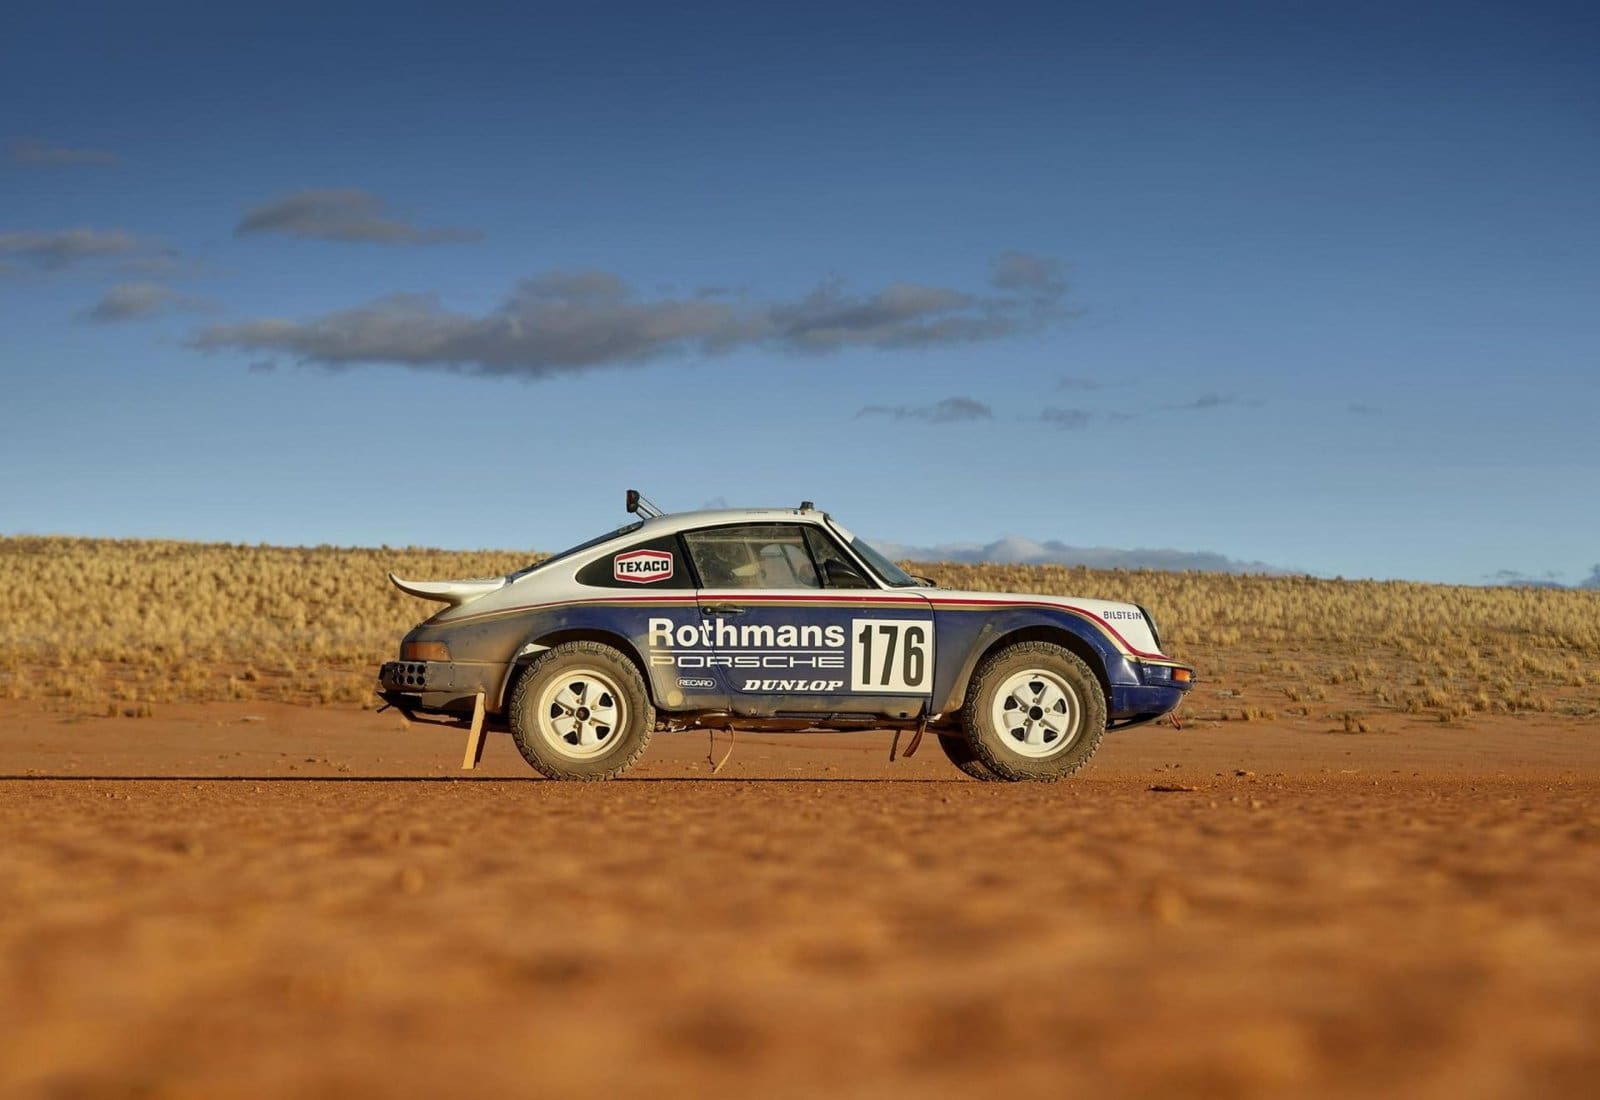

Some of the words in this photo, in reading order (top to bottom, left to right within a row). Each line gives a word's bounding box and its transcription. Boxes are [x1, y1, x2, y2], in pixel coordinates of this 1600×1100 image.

[618, 560, 669, 573] TEXACO
[1103, 611, 1142, 620] BILSTEIN
[648, 617, 845, 648] Rothmans
[650, 656, 845, 668] PORSCHE
[859, 624, 925, 687] 176
[679, 679, 714, 687] RECARO
[742, 679, 844, 692] DUNLOP
